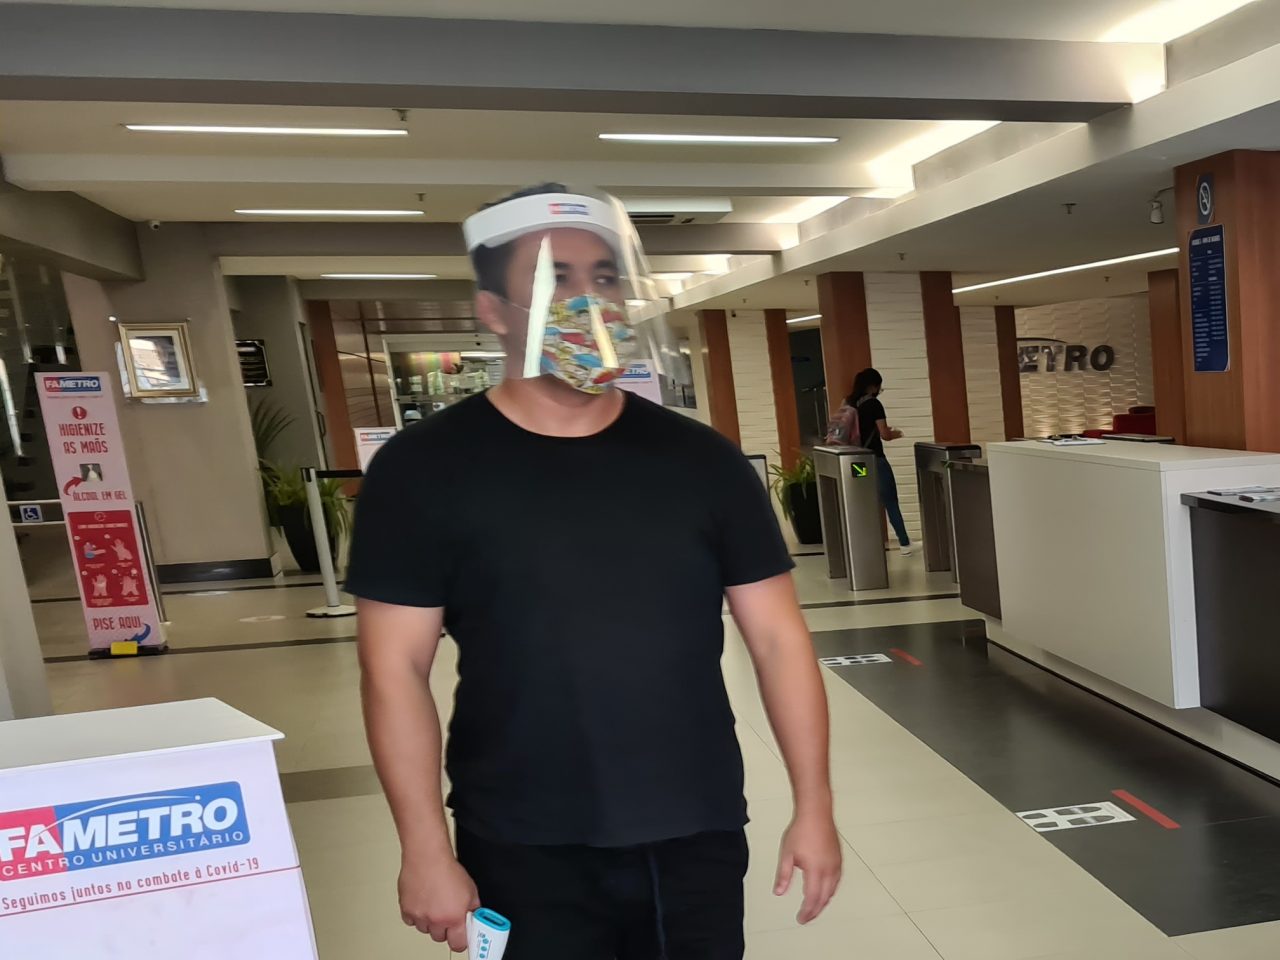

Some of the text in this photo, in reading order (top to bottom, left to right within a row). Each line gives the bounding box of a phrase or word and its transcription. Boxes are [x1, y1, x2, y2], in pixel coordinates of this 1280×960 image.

[46, 379, 99, 388] FAMETRO
[58, 422, 106, 436] HIGIENIZE
[63, 441, 76, 454] AS
[102, 490, 113, 500] EM
[114, 490, 127, 500] GEL
[93, 616, 141, 631] PISE AQUI
[0, 797, 239, 862] FAMETRO
[2, 830, 244, 877] CENTRO UNIVERSITÁRIO
[2, 890, 67, 911] Seguimos
[71, 883, 112, 902] juntos
[137, 869, 190, 889] combate
[195, 866, 202, 879] à
[206, 857, 260, 877] Covid-19
